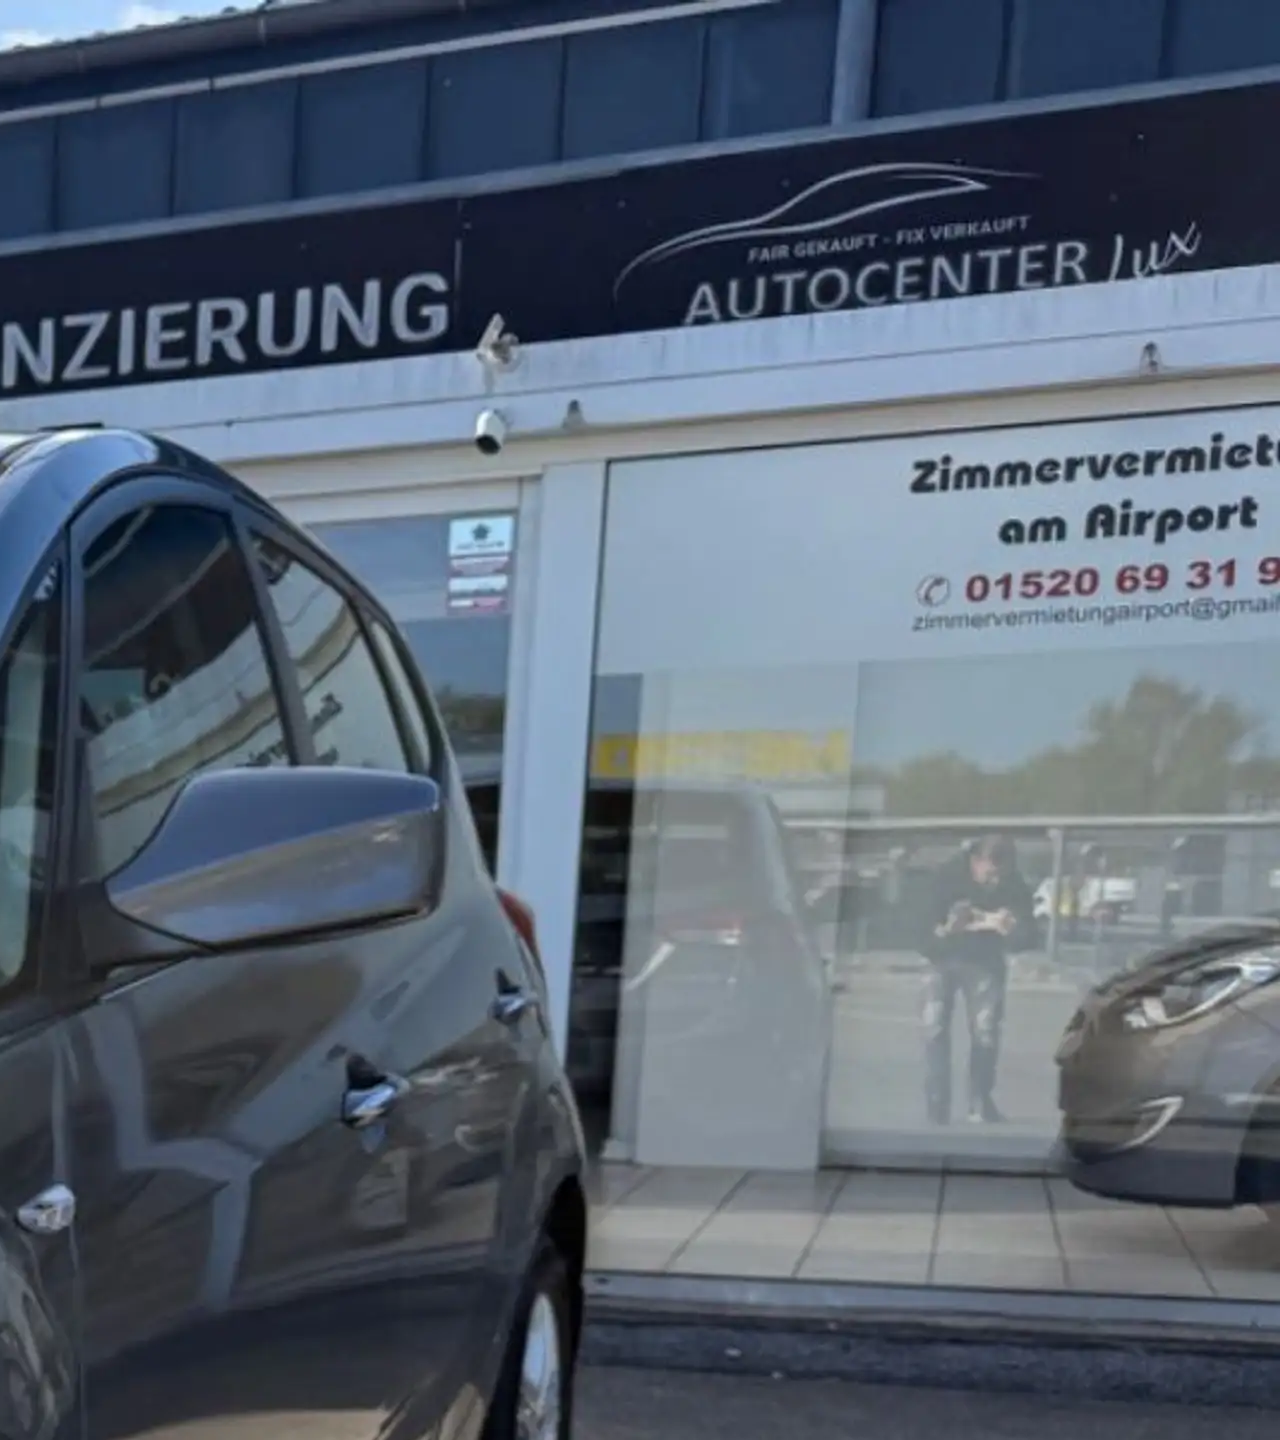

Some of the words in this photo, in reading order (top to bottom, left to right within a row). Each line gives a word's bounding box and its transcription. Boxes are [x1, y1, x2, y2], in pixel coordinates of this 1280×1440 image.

[747, 243, 789, 263] FAIR
[793, 233, 877, 258] GEKAUFT
[896, 227, 925, 245] FIX
[929, 214, 1032, 240] VERKAUFT
[684, 241, 1088, 326] AUTOCENTER
[910, 432, 1280, 494] Zimmervermiet
[998, 514, 1068, 545] am
[1085, 496, 1259, 544] Airport
[965, 567, 1099, 602] 01520
[1116, 563, 1169, 594] 69
[1186, 557, 1236, 589] 31
